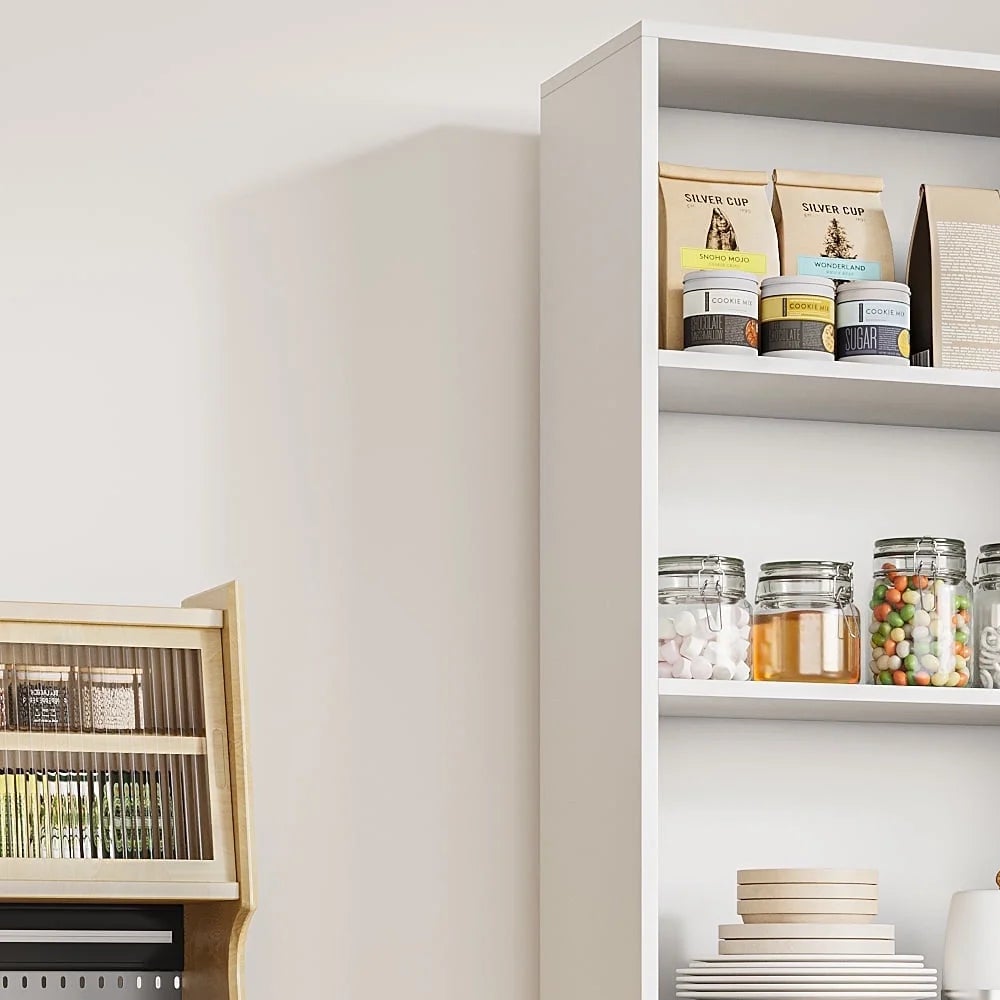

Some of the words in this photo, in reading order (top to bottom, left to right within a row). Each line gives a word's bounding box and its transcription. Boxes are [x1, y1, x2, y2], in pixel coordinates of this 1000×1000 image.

[684, 193, 723, 205] SILVER
[726, 196, 749, 207] CUP
[802, 202, 840, 214] SILVER
[843, 206, 865, 216] CUP
[728, 256, 750, 264] MOJO
[814, 261, 866, 272] WONDERLAND
[712, 297, 741, 305] COOKIE
[789, 303, 819, 311] COOKIE
[865, 308, 894, 316] COOKIE
[845, 326, 877, 351] SUGAR
